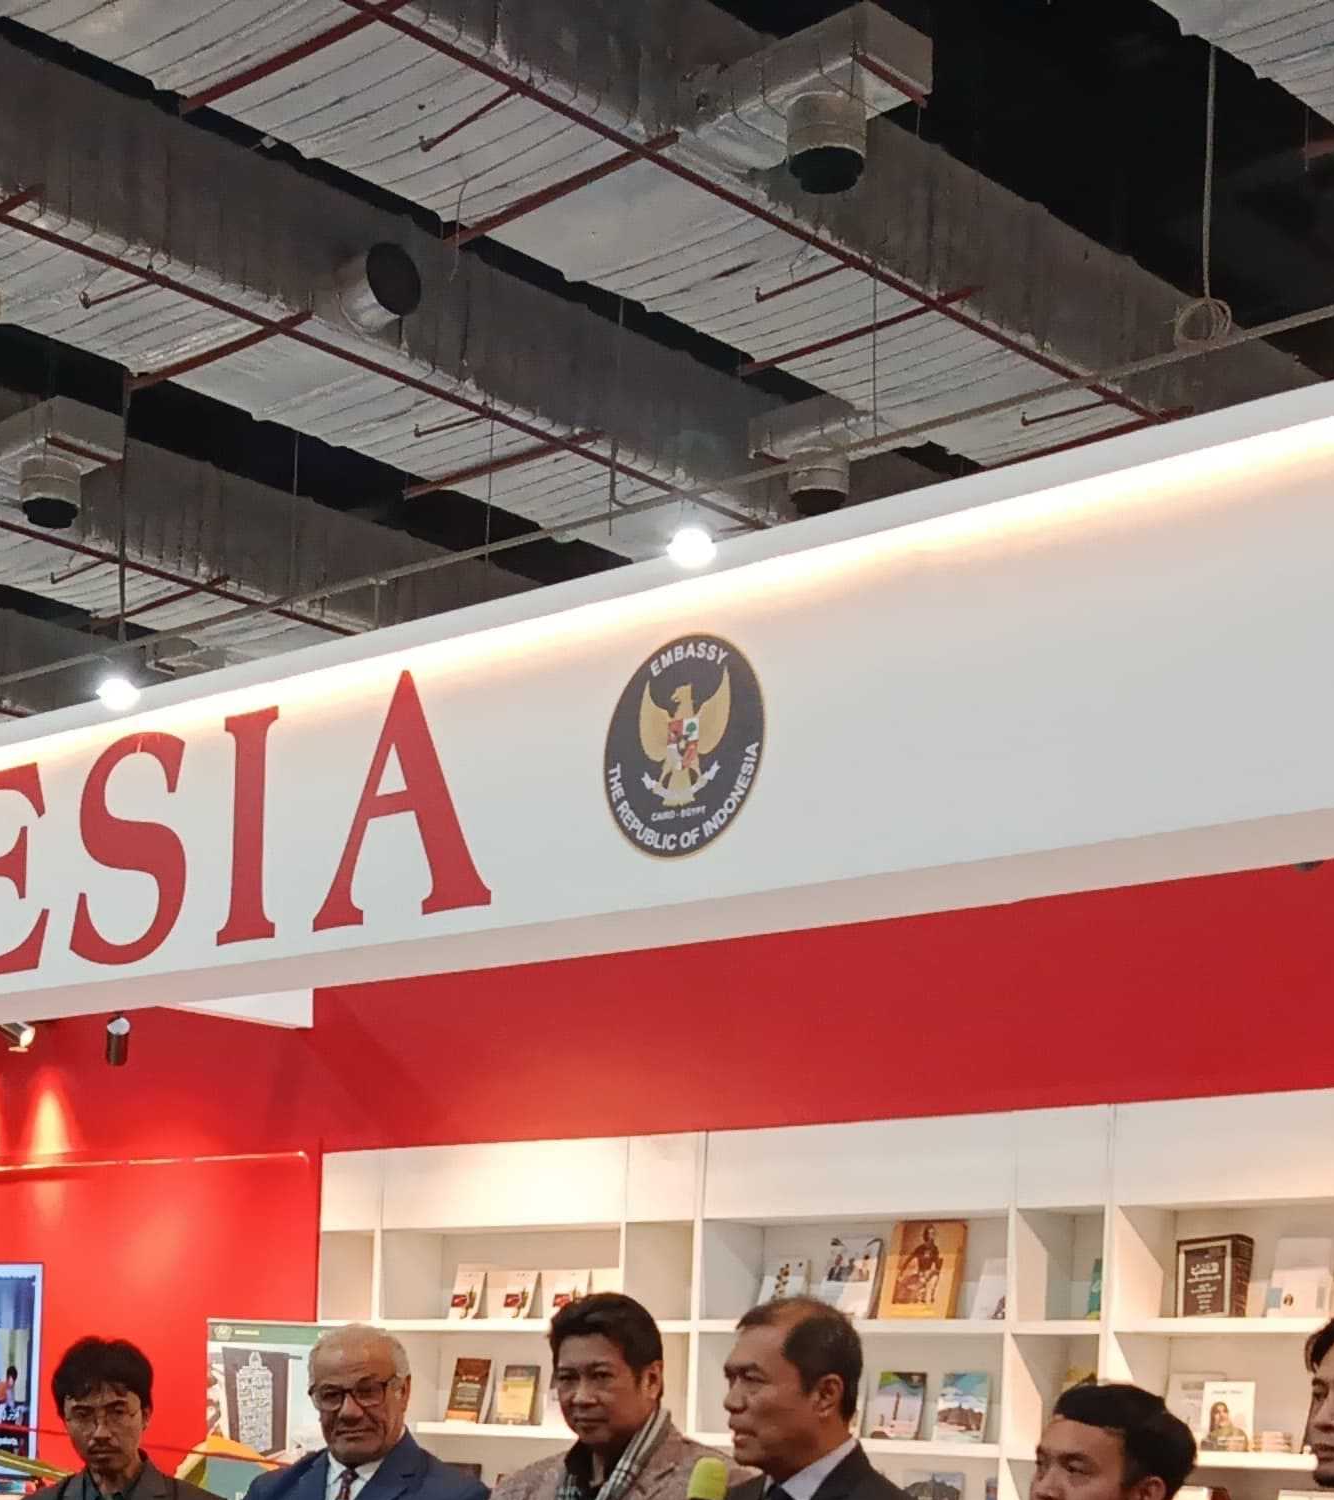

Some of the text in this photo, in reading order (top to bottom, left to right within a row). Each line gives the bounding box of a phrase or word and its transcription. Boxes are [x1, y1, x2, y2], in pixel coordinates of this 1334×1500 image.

[650, 641, 729, 677] EMBASSY
[608, 741, 761, 851] THE REPUBLIC OF INDONESIA
